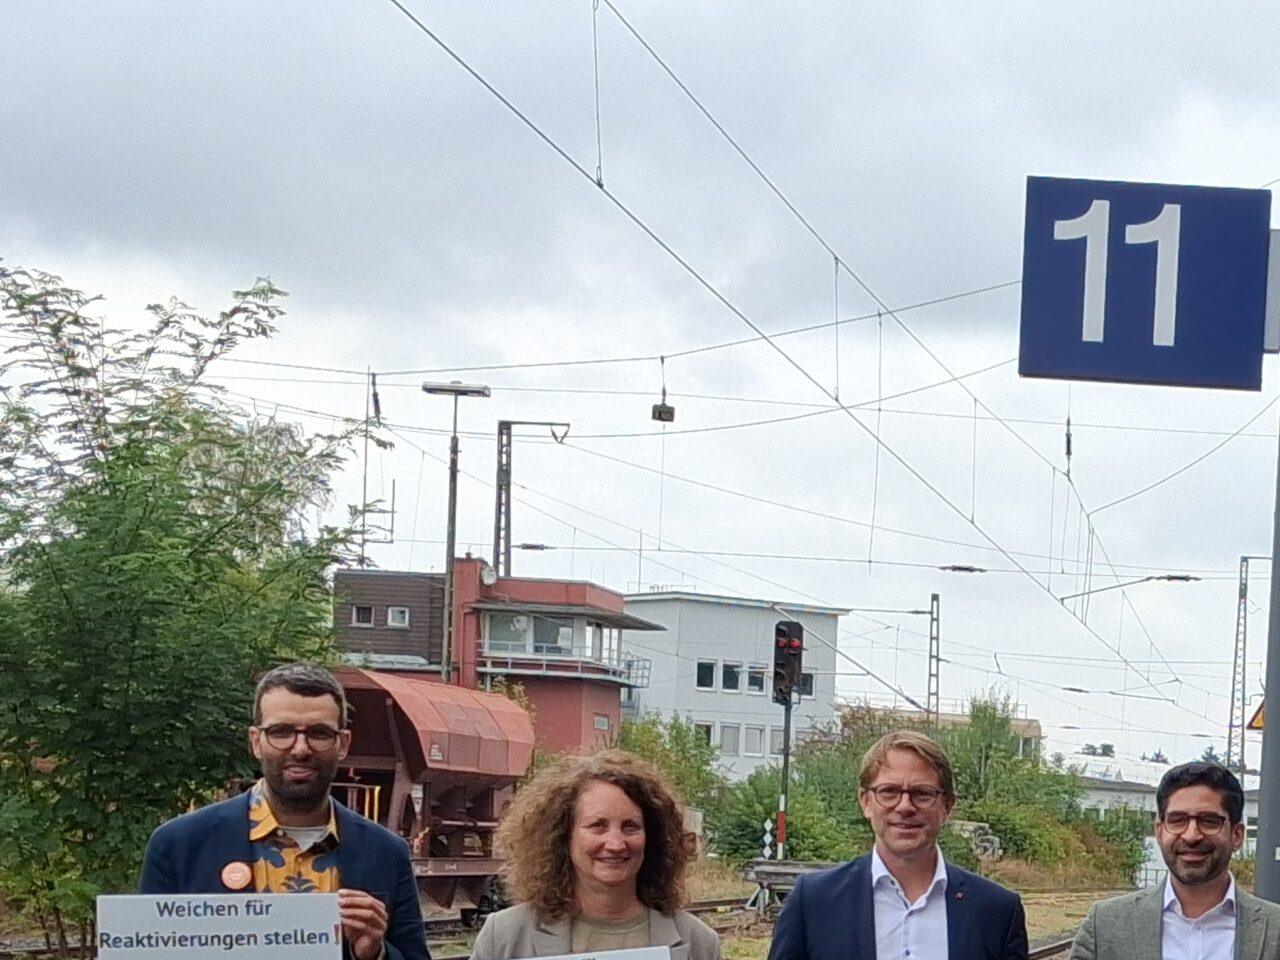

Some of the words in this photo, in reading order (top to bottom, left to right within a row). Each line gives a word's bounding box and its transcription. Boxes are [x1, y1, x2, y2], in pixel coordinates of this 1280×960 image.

[1052, 199, 1182, 347] 11
[156, 900, 239, 919] Weichen
[245, 898, 273, 919] für
[99, 928, 259, 951] Reaktivierungen
